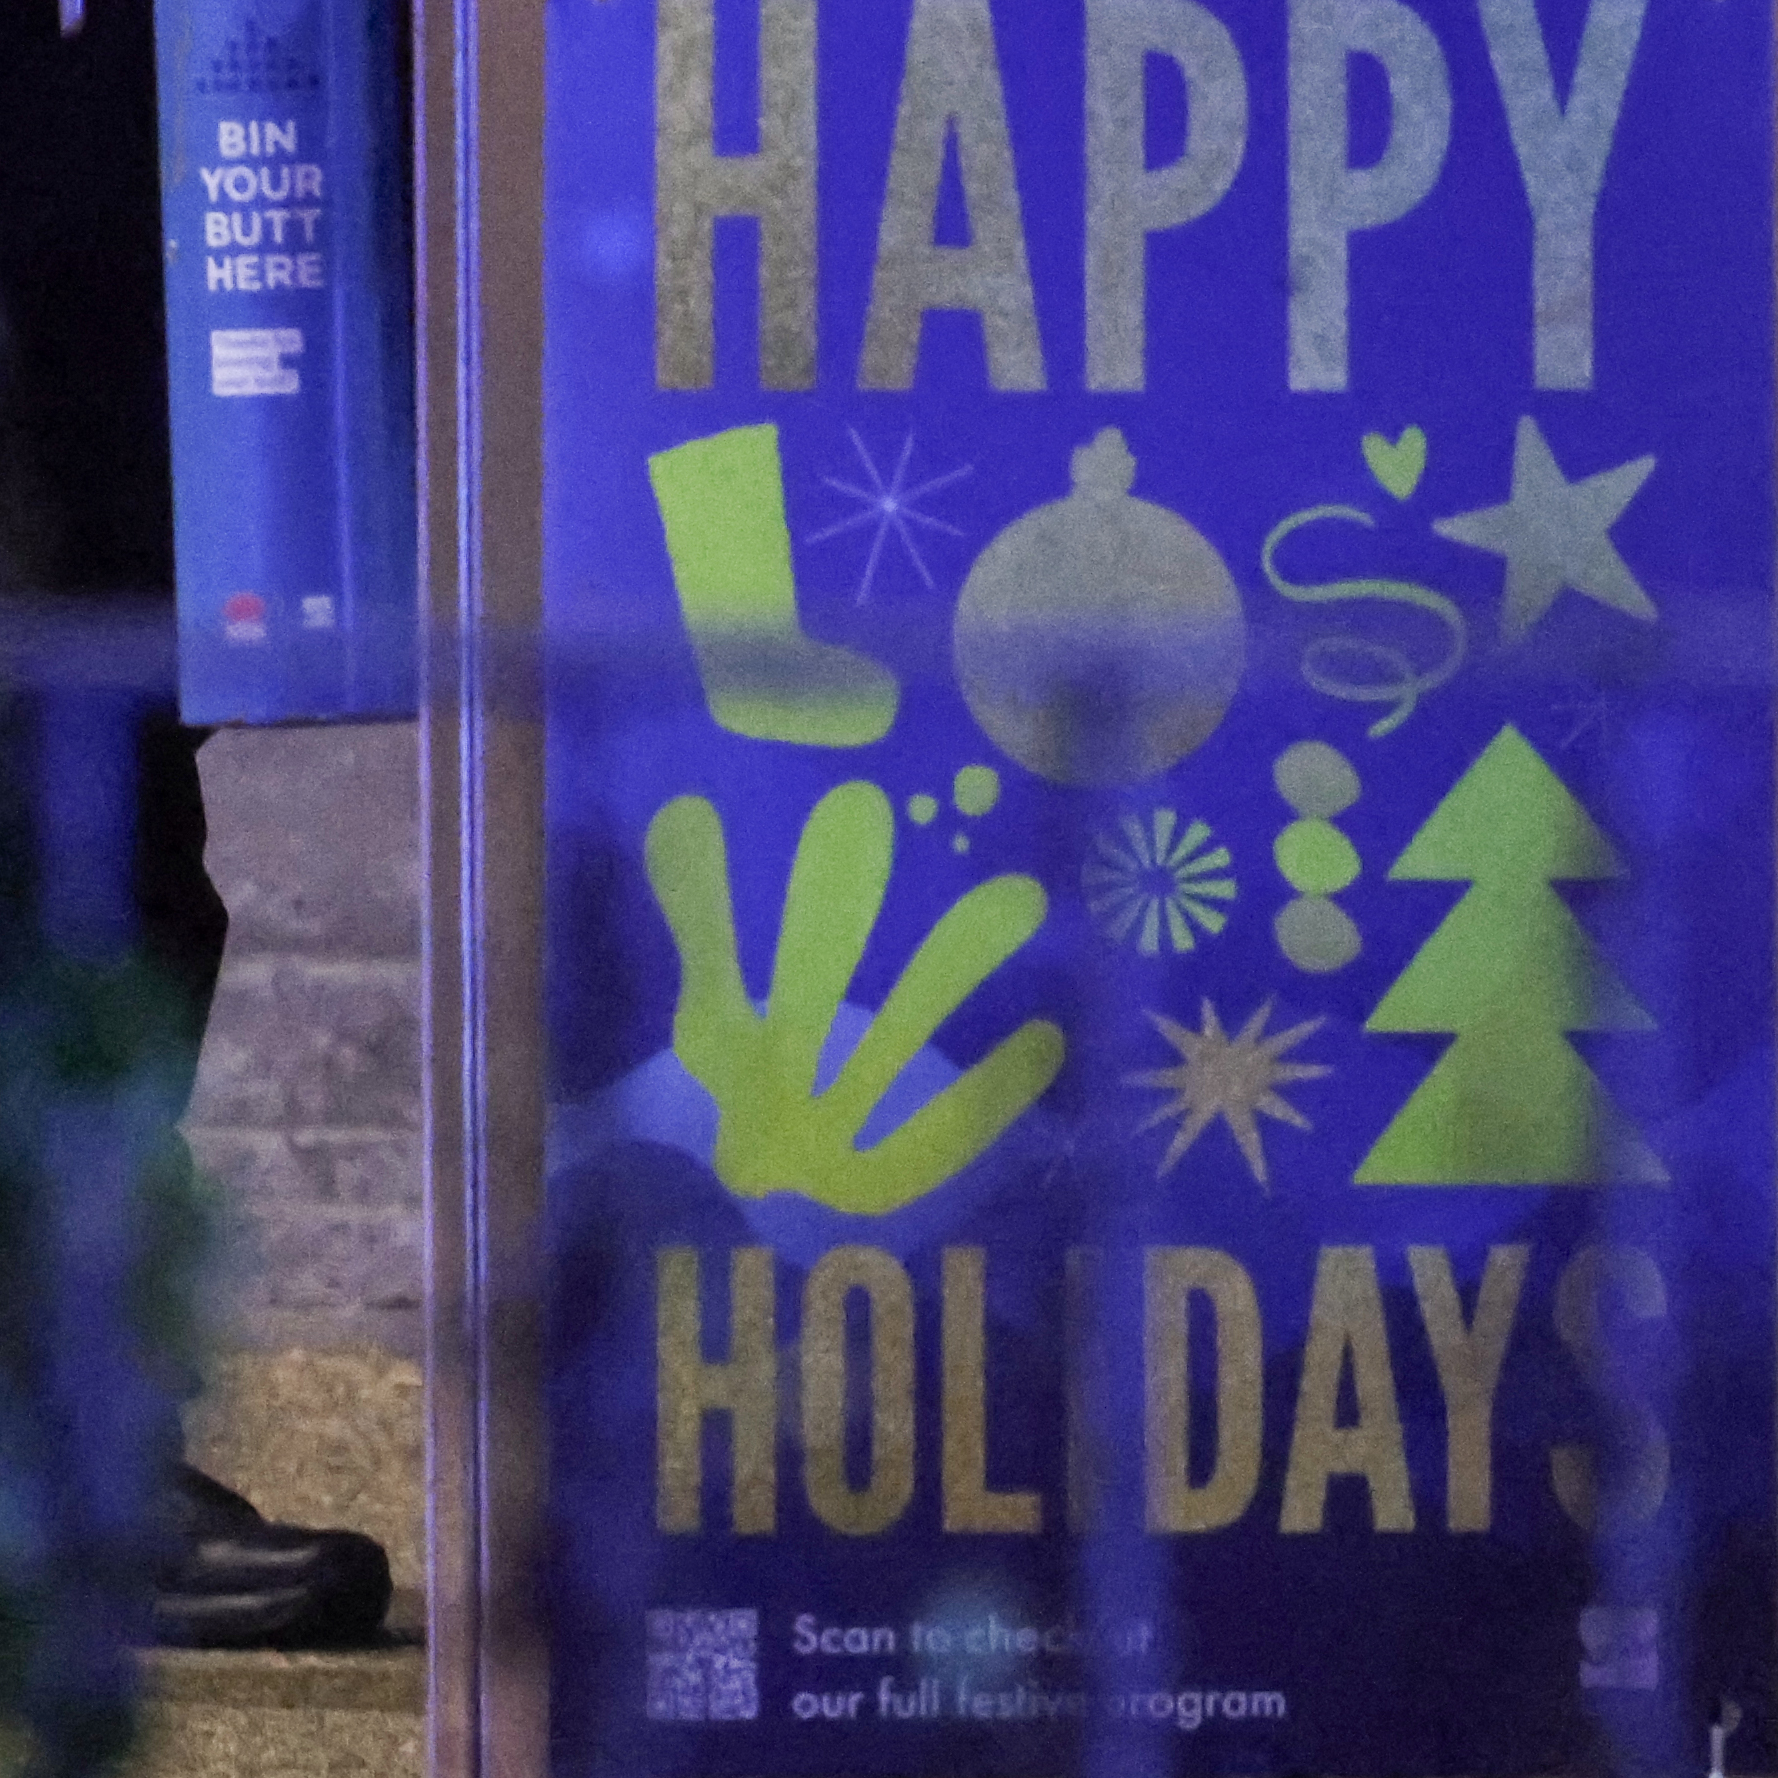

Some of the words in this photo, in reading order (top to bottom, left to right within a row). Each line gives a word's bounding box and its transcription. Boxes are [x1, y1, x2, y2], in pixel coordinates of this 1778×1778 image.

[218, 120, 297, 158] BIN
[199, 163, 322, 203] YOUR
[205, 207, 322, 247] BUTT
[206, 251, 322, 291] HERE
[793, 1612, 896, 1654] Scan
[911, 1621, 952, 1653] to
[966, 1612, 1084, 1653] chec
[791, 1690, 864, 1719] our
[877, 1674, 941, 1719] full
[1101, 1690, 1287, 1730] rogram
